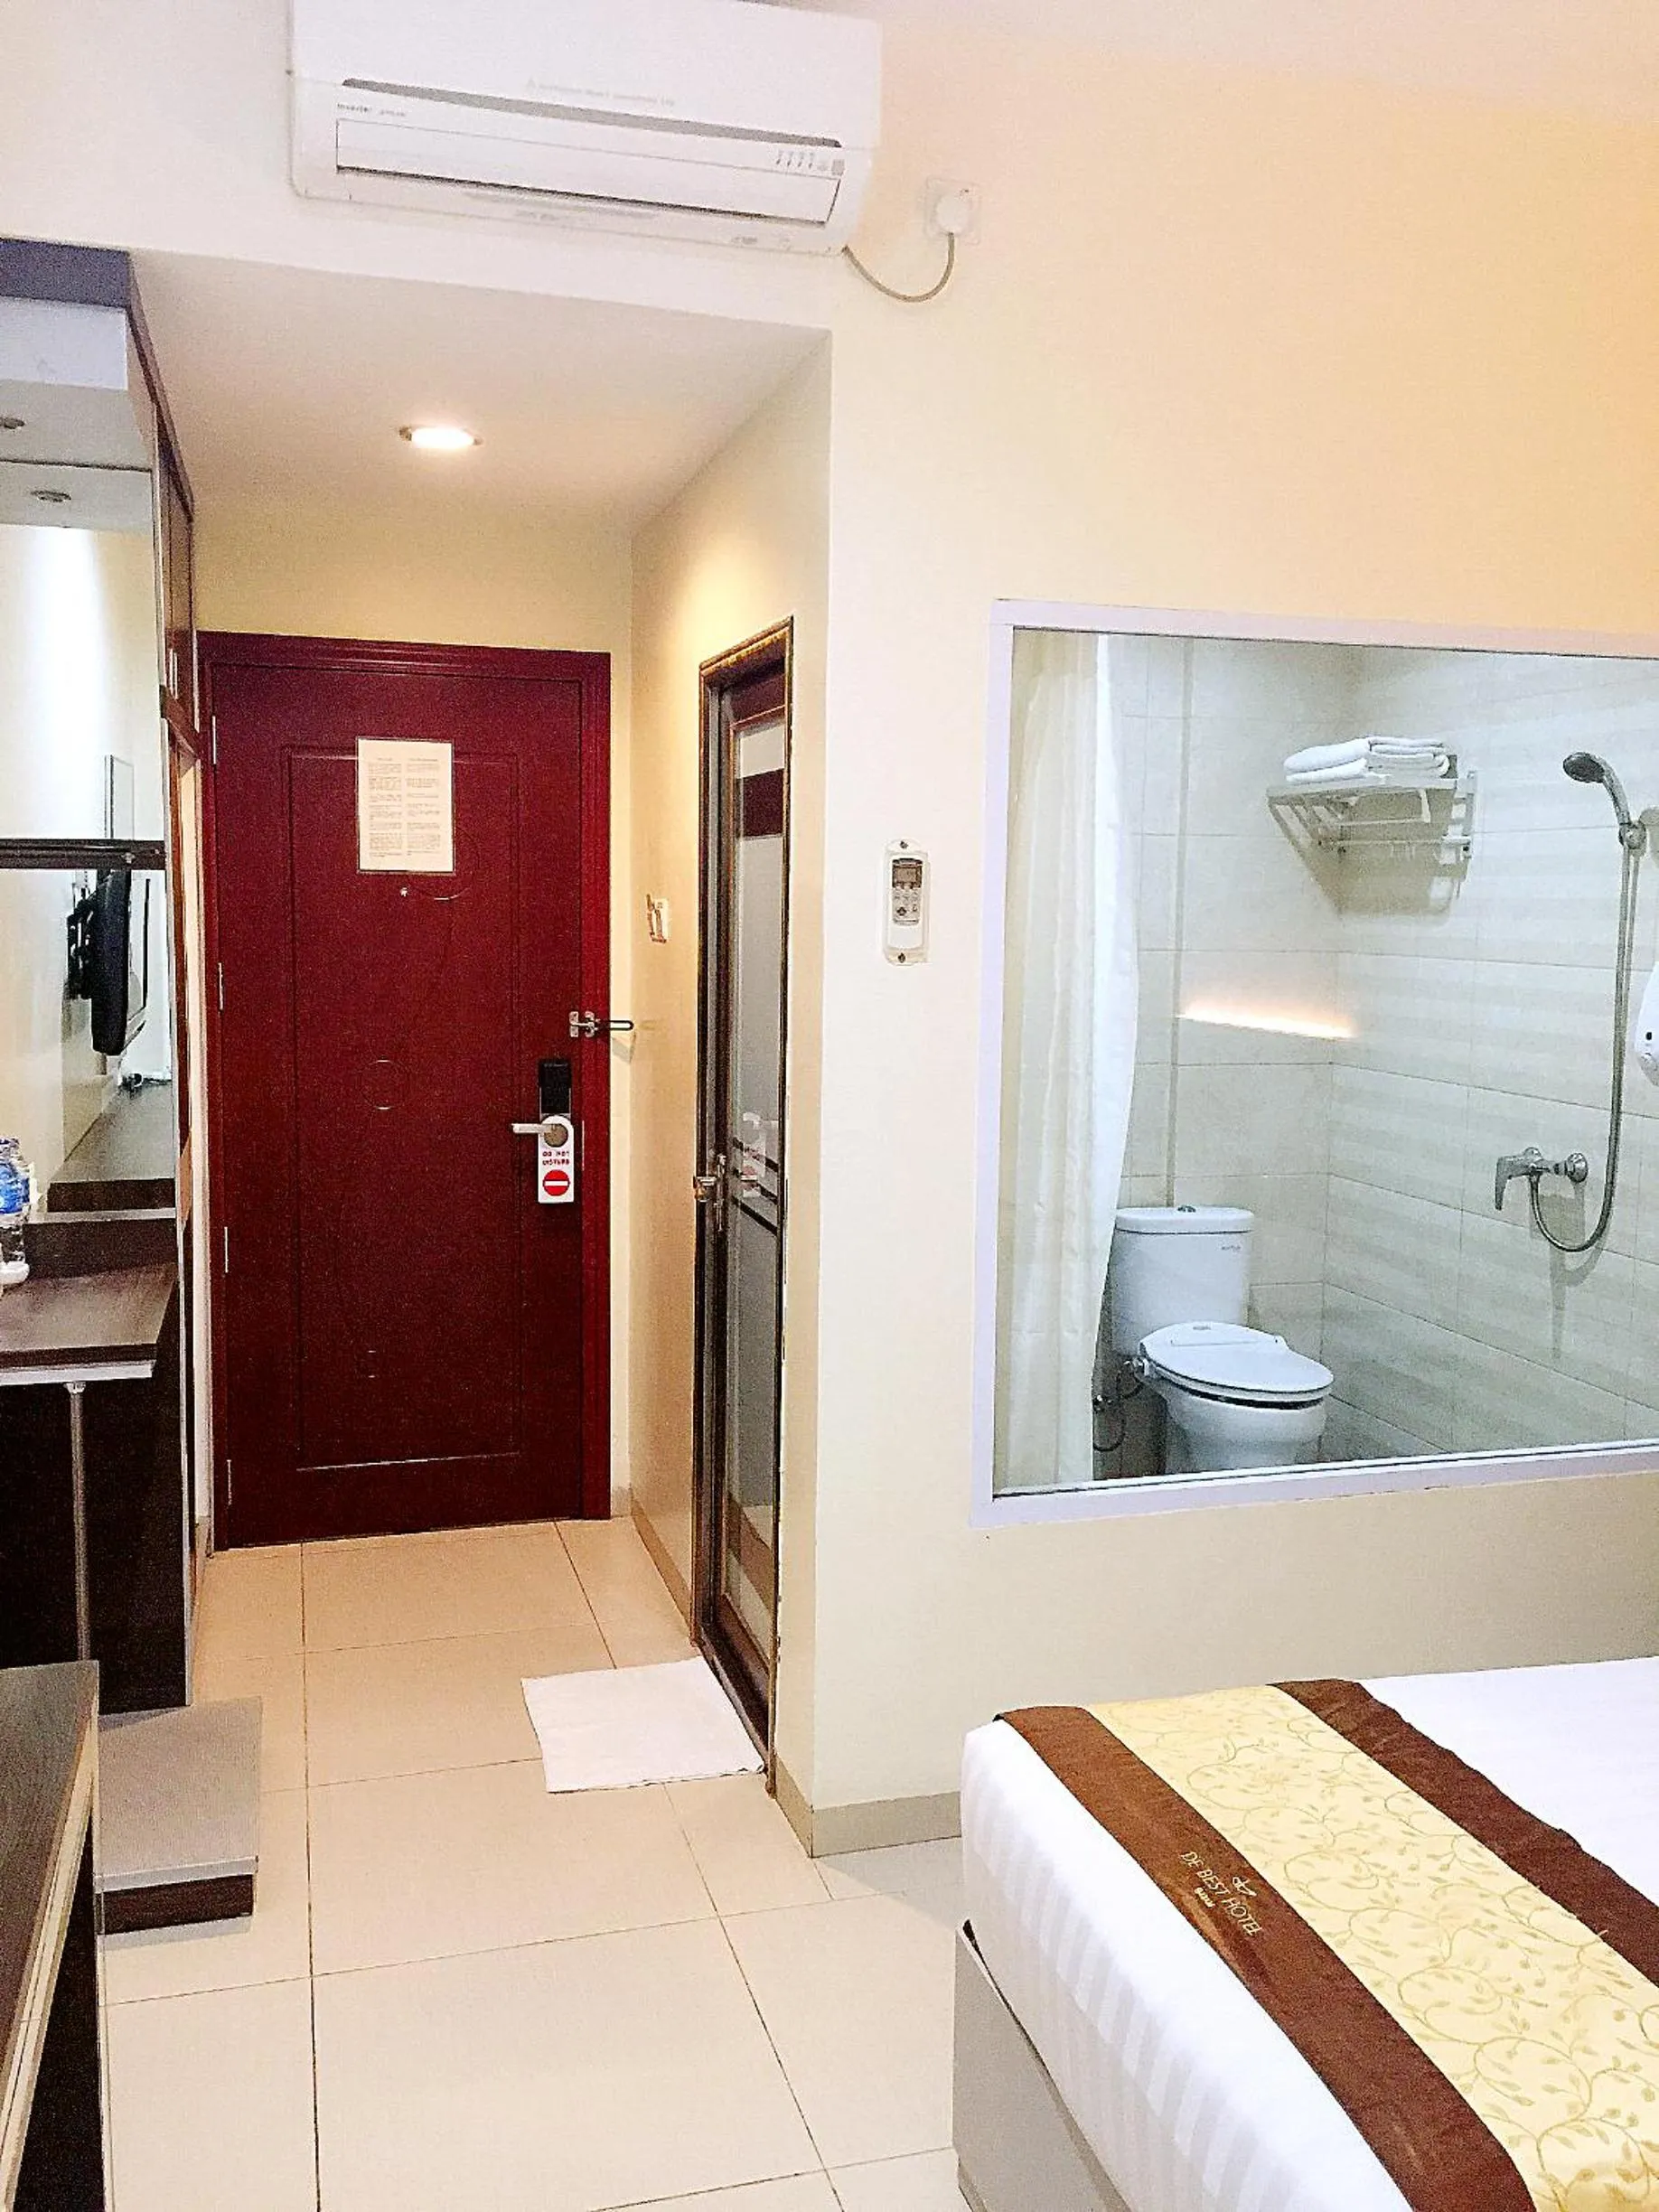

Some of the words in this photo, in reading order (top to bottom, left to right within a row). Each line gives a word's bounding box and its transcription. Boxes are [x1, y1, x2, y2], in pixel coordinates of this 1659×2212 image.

[1180, 1851, 1204, 1869] DE
[1196, 1869, 1231, 1896] BEST
[1221, 1897, 1263, 1936] HOTEL
